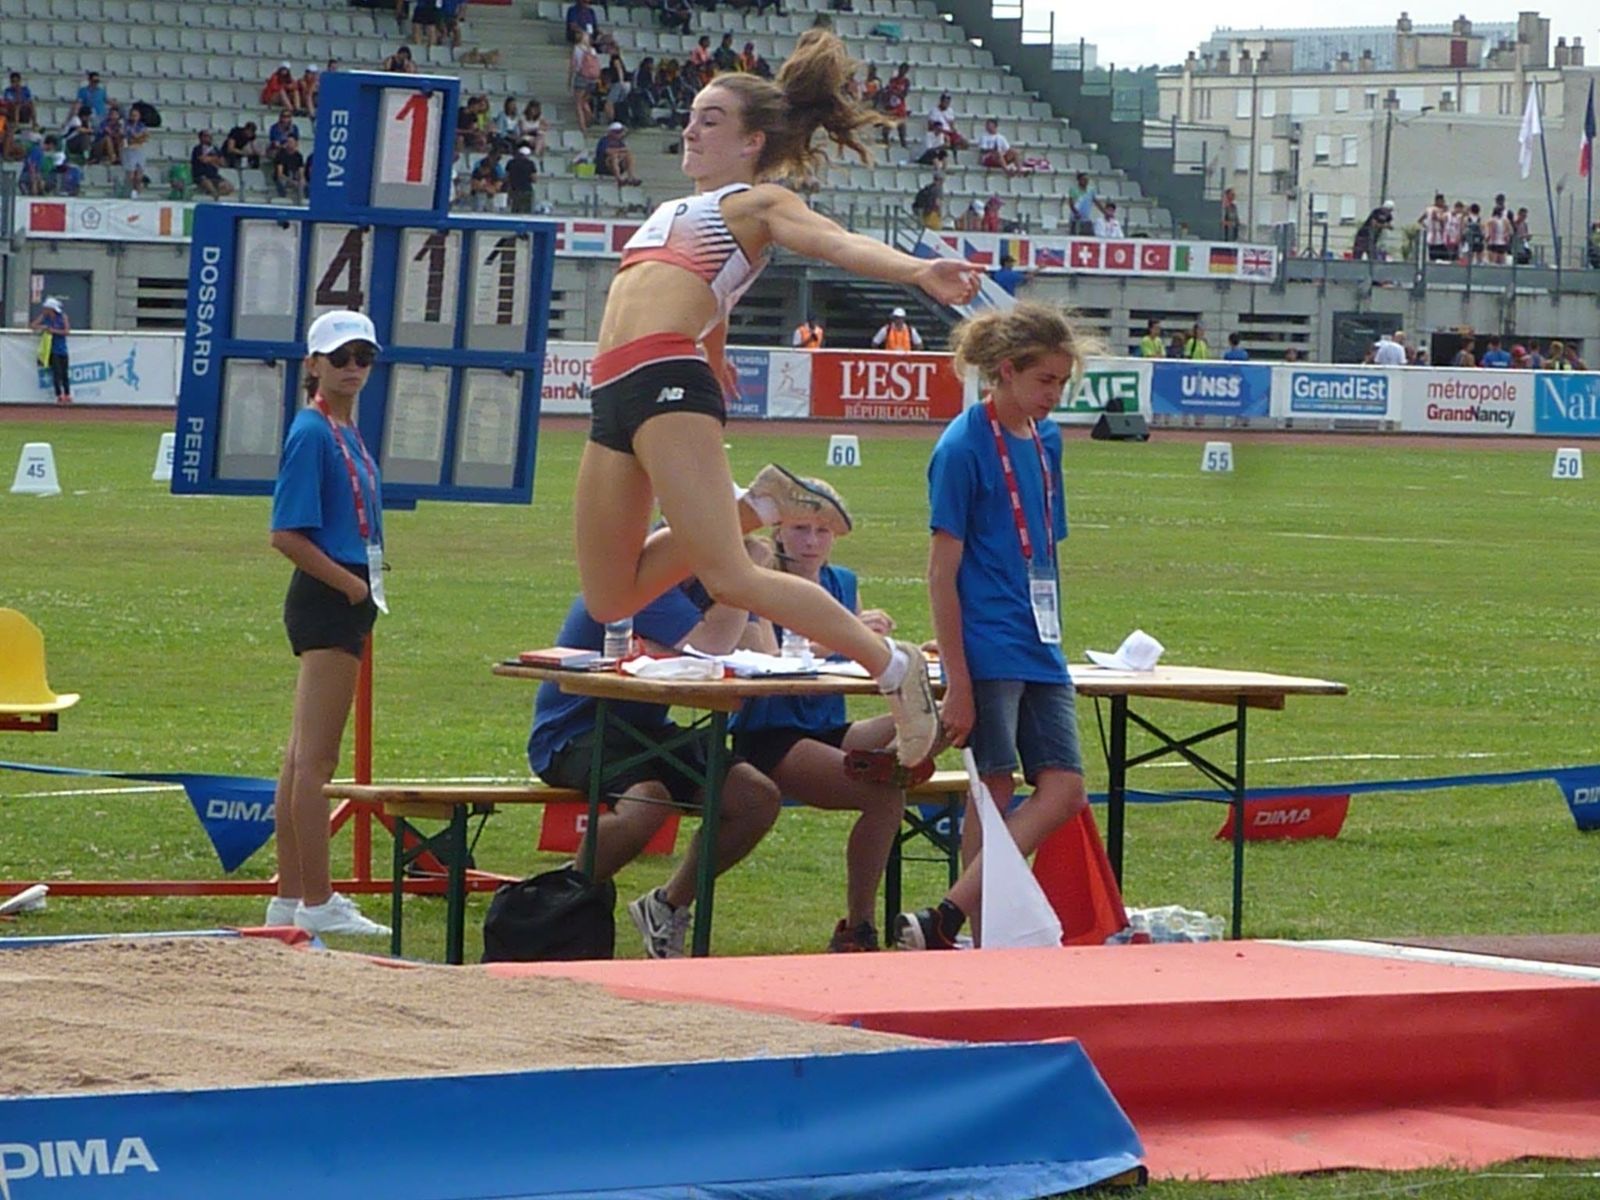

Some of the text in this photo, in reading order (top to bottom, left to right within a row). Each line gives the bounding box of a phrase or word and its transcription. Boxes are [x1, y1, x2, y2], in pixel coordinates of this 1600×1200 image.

[326, 109, 349, 187] ESSAI
[395, 93, 429, 183] 1
[315, 227, 517, 325] 4 1 1
[192, 246, 221, 376] DOSSARD
[544, 353, 592, 381] étrop
[840, 360, 936, 401] L'EST
[1060, 376, 1136, 408] AIF
[1427, 377, 1517, 404] métropole
[845, 402, 930, 420] RÉPUBLICAIN
[1427, 403, 1516, 428] GrandNancy
[182, 416, 204, 485] PERF
[832, 445, 856, 466] 60
[1207, 451, 1229, 471] 55
[26, 463, 46, 479] 45
[1557, 457, 1579, 476] 50
[206, 799, 276, 822] DIMA
[1253, 808, 1311, 825] DIMA
